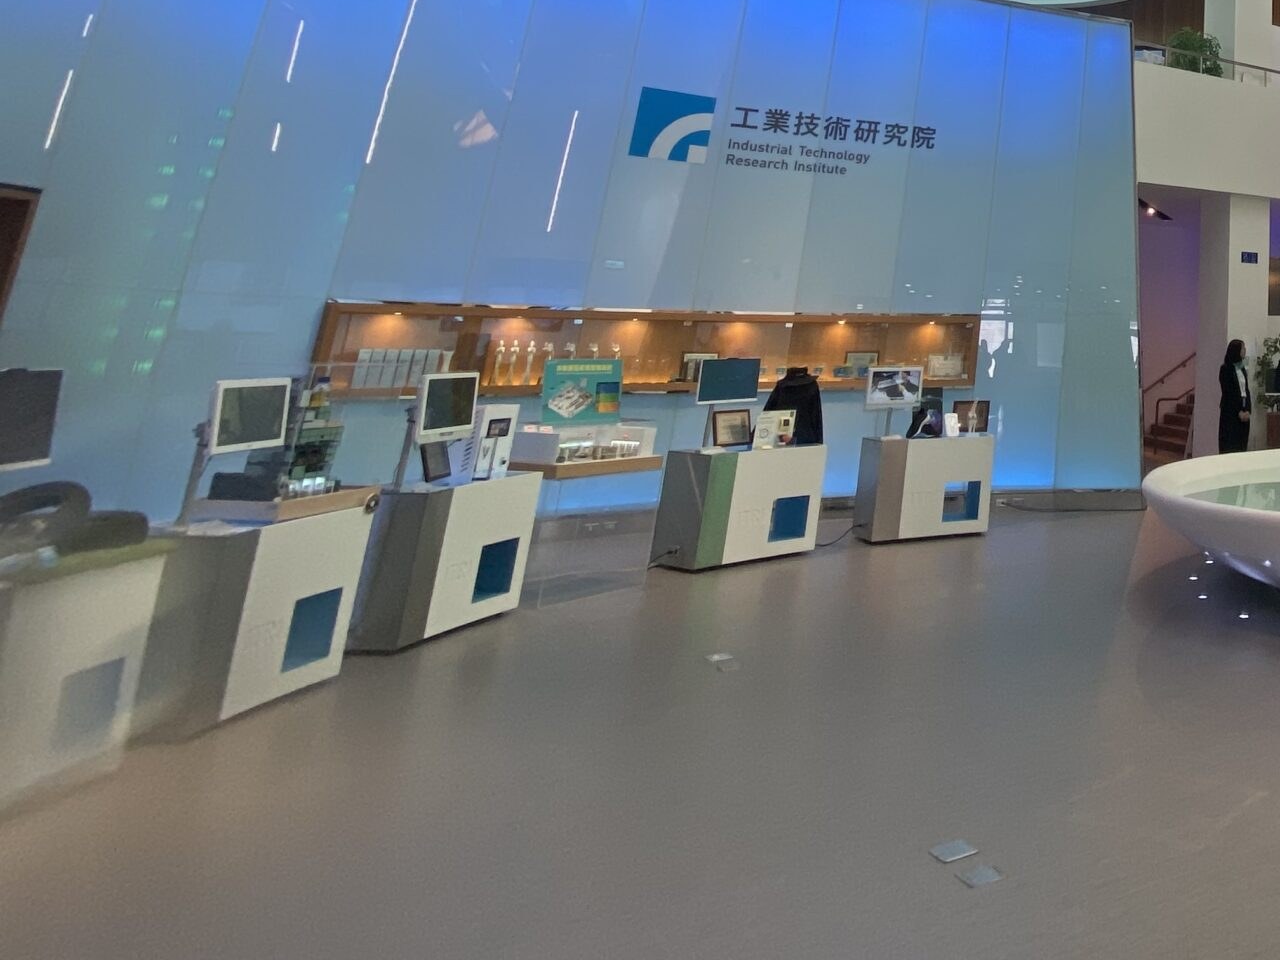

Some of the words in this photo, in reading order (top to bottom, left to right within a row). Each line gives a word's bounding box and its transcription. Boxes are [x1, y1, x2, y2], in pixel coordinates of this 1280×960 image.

[730, 106, 937, 150] 工業技術研究院
[725, 154, 789, 171] Research
[794, 160, 848, 175] Institute
[727, 138, 793, 156] Industrial
[799, 145, 870, 165] Technology
